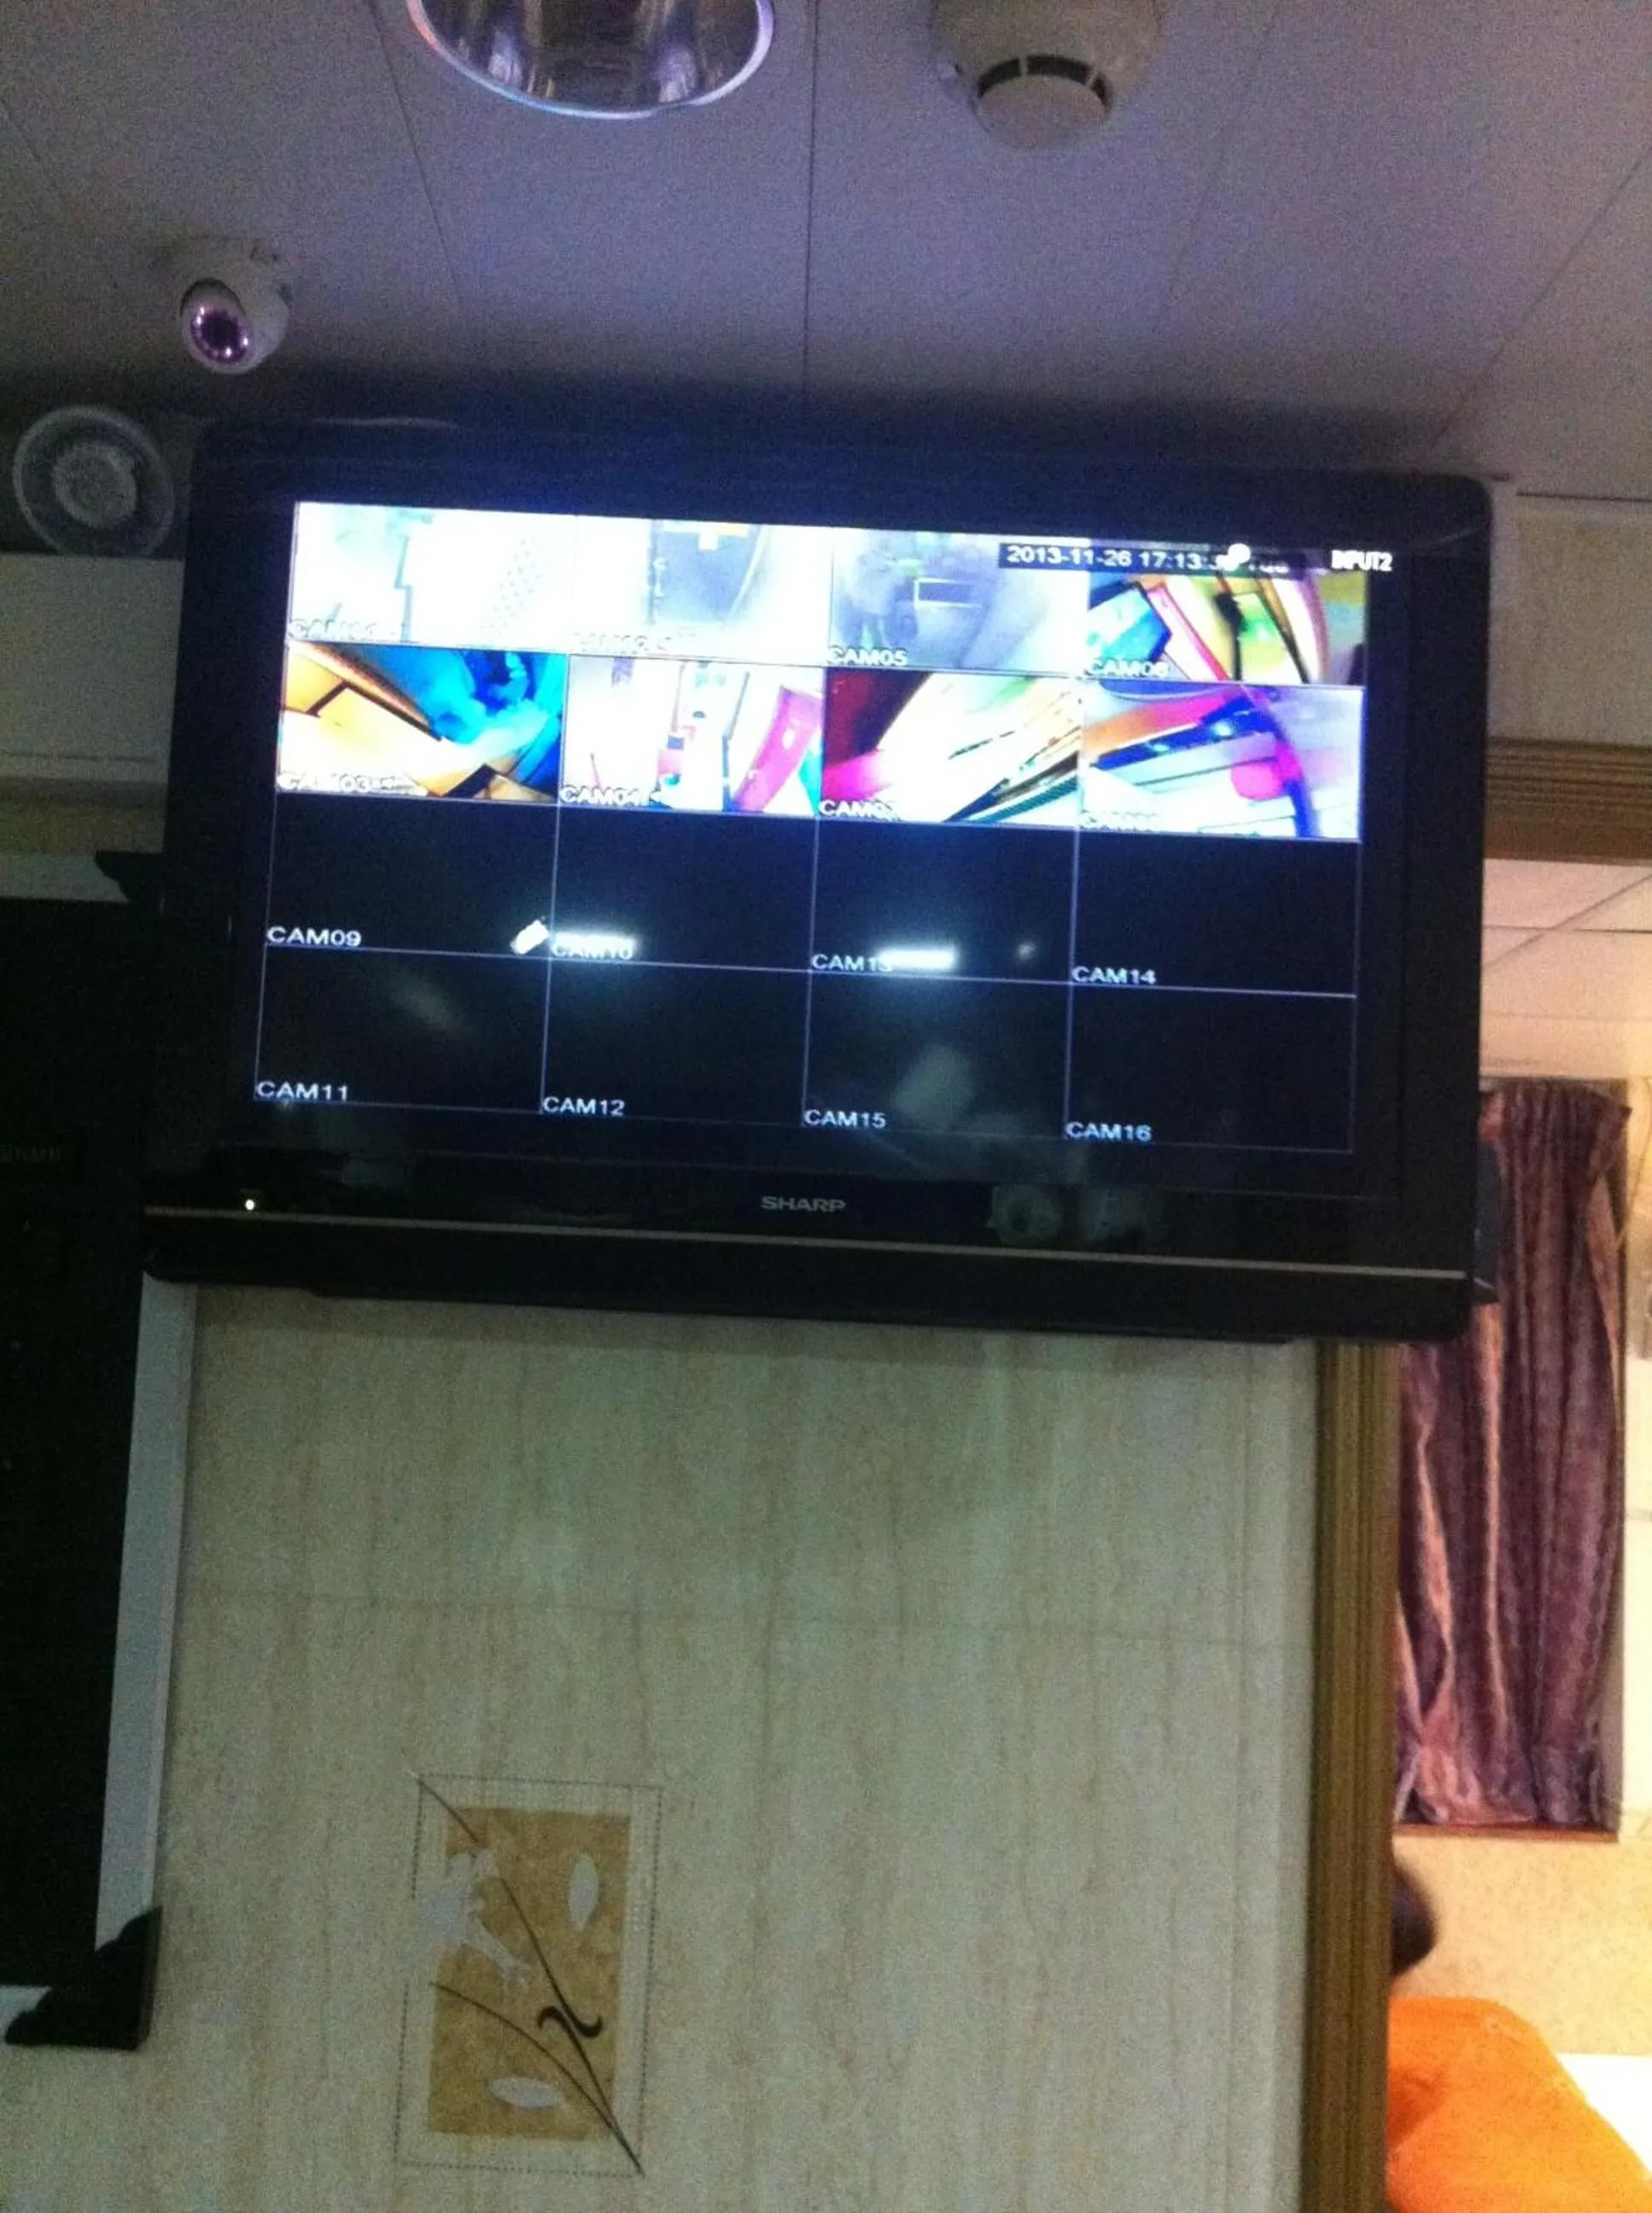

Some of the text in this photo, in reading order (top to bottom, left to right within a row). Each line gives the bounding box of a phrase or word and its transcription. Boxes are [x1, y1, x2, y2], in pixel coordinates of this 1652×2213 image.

[1007, 545, 1131, 567] 2013-11-26
[828, 646, 908, 667] CAM05
[277, 772, 372, 794] CA03
[819, 799, 897, 821] CAM0
[266, 925, 362, 948] CAM09
[1071, 965, 1157, 986] CAM14
[257, 1080, 348, 1102] CAM11
[542, 1095, 625, 1118] CAM12
[803, 1108, 887, 1130] CAM15
[1065, 1121, 1153, 1143] CAM16
[761, 1195, 847, 1212] SHARP
